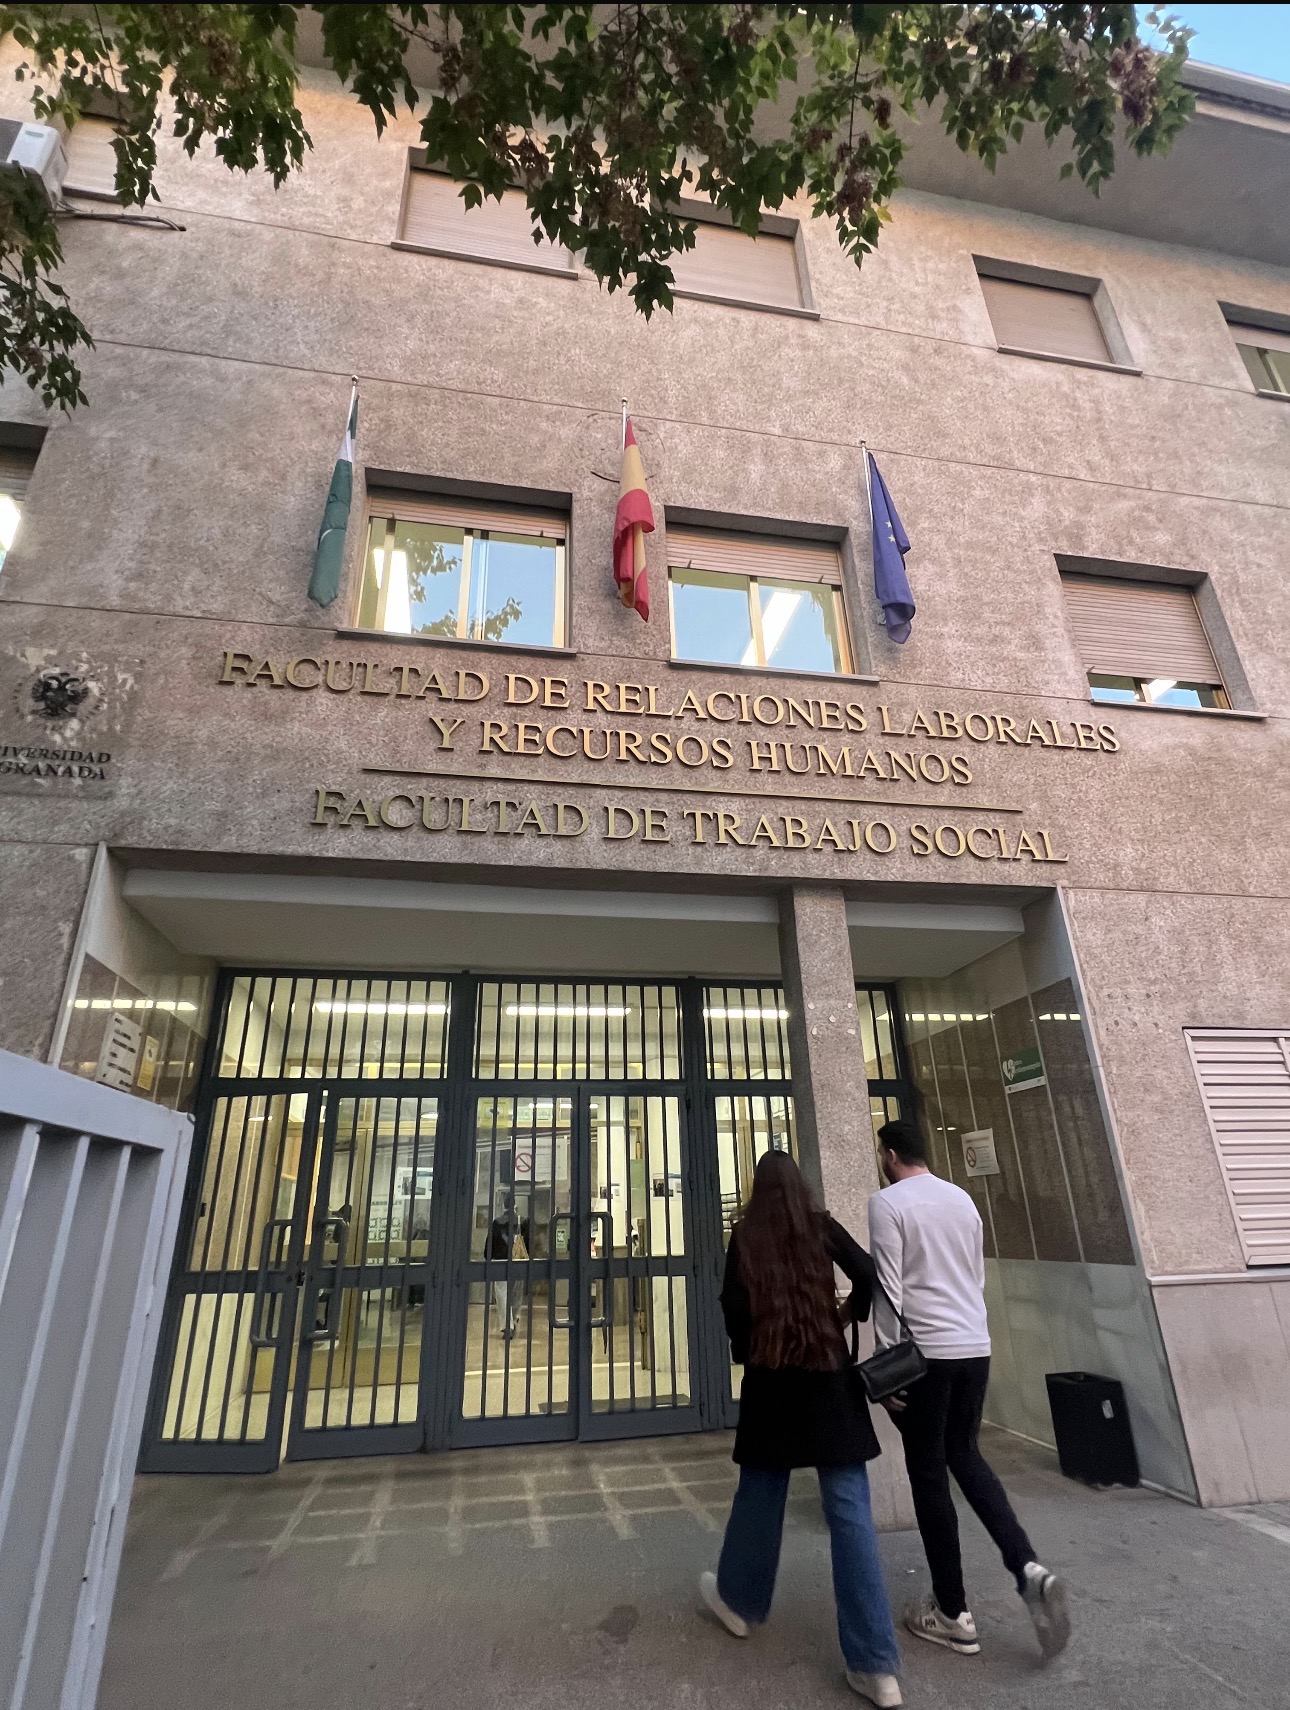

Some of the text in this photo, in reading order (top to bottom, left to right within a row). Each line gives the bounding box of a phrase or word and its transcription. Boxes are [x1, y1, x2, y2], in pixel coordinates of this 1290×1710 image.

[219, 650, 1121, 753] FACULTAD DE RELACIONES LABORALES
[0, 746, 111, 763] IVERSIDAD
[0, 761, 105, 779] GRANADA
[430, 716, 974, 785] Y RECURSOS HUMANOS
[311, 788, 1069, 863] FACULTAD DE TRABAJO SOCIAL
